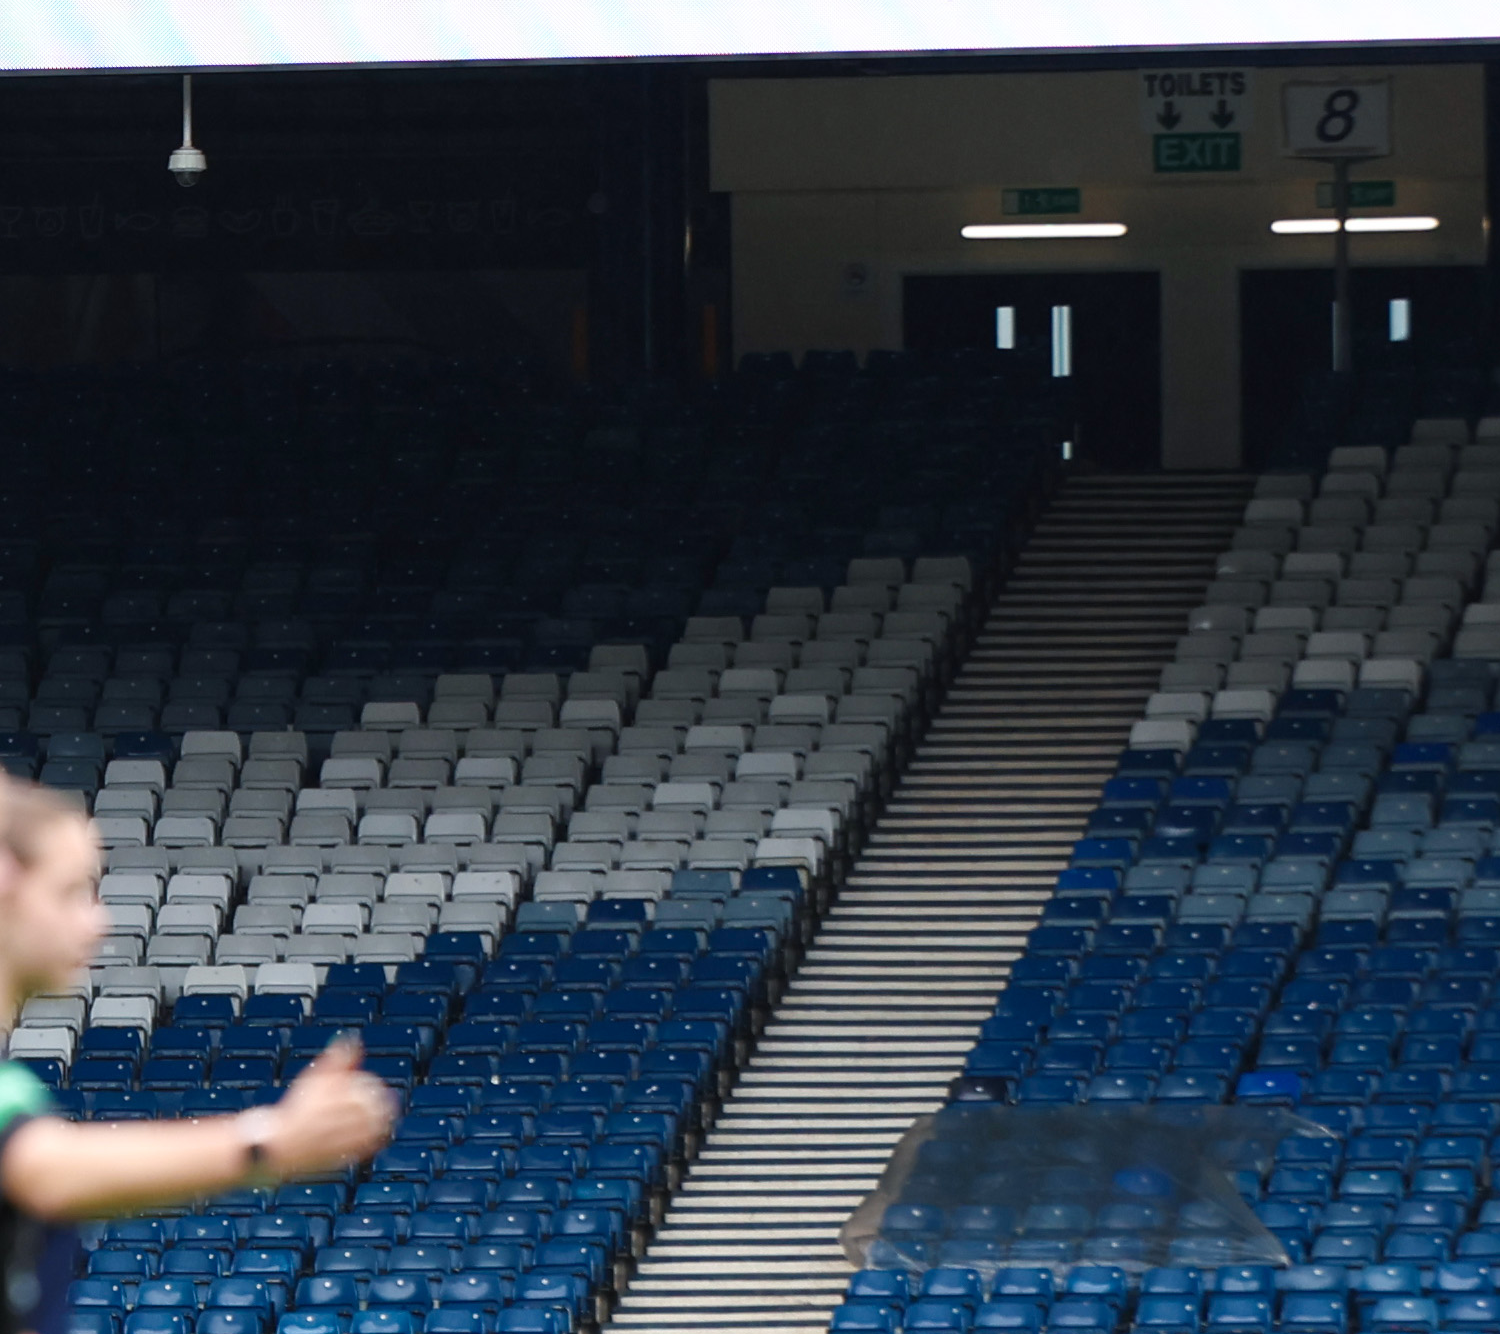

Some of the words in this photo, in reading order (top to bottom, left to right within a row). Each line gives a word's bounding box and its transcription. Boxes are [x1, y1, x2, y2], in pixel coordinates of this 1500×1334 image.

[1143, 71, 1246, 98] TOILETS
[1316, 89, 1359, 142] 8
[1158, 137, 1236, 169] EXIT
